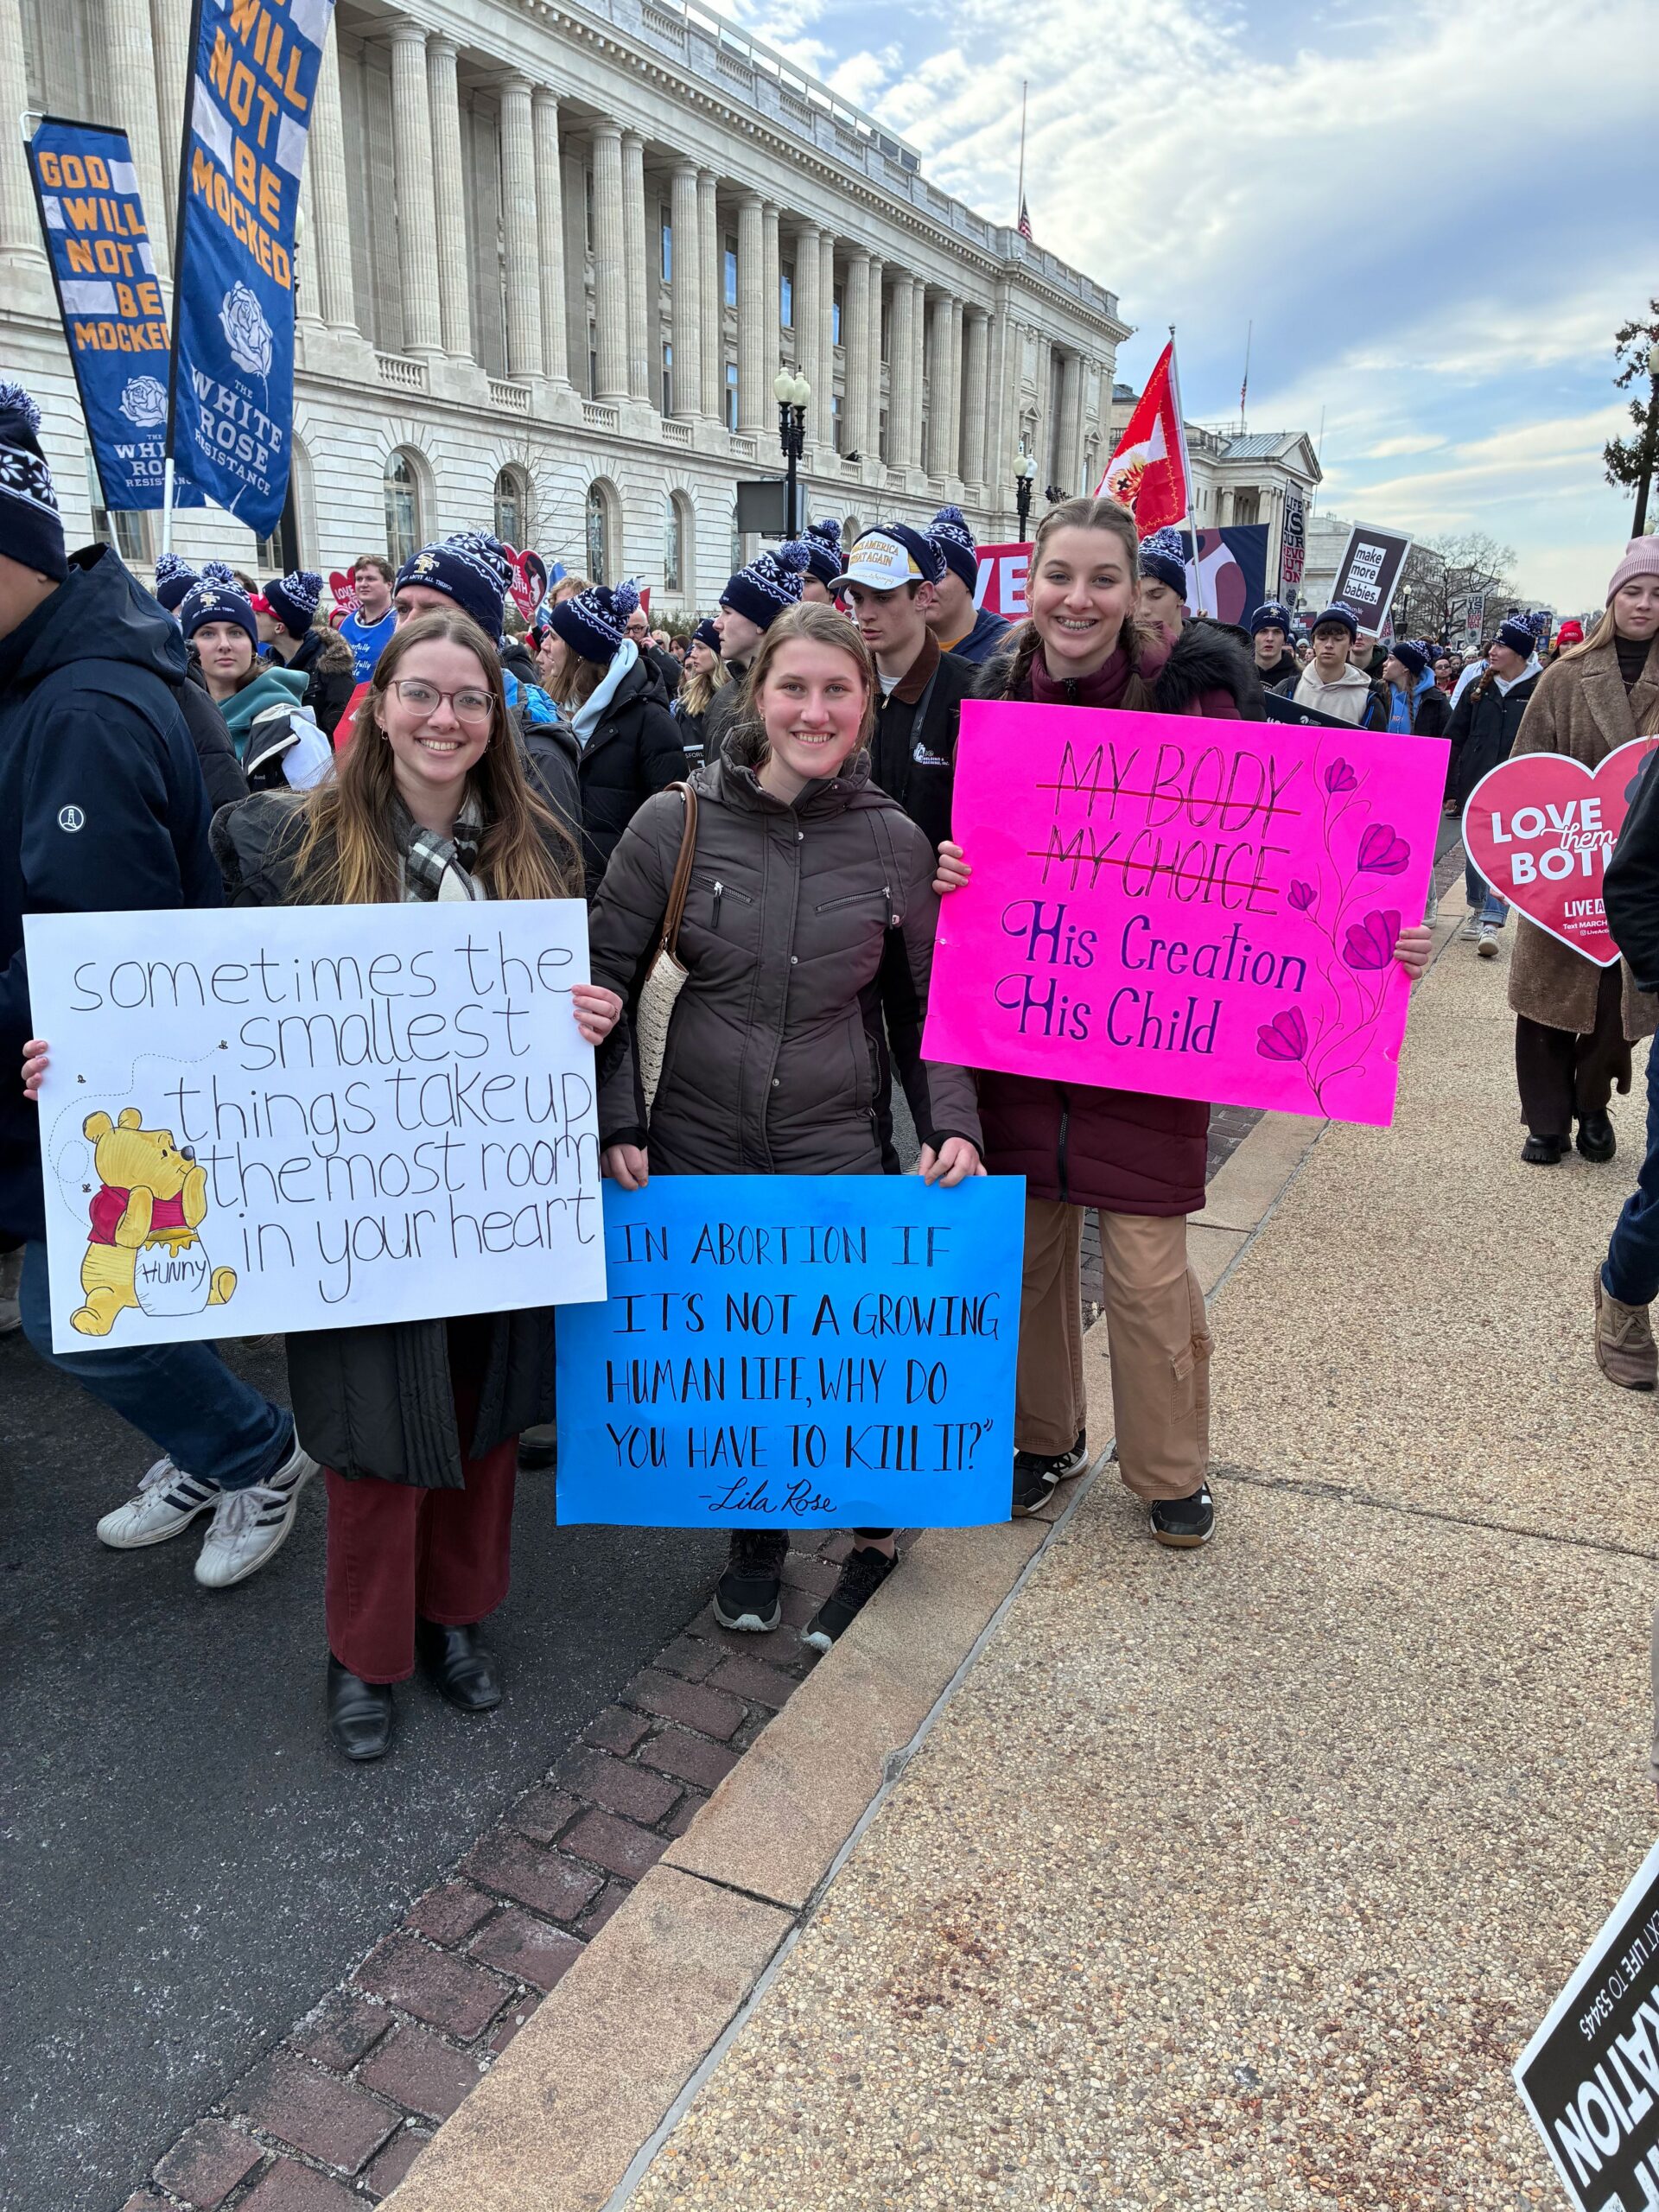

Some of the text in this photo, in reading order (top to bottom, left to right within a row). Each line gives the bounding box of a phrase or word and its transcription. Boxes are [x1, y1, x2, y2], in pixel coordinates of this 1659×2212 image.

[230, 0, 307, 111] WILL
[209, 26, 278, 149] NOT
[39, 152, 110, 189] GOD
[234, 136, 282, 232] BE
[62, 197, 147, 236] WILL
[192, 148, 291, 290] MOCKED
[66, 239, 134, 276] NOT
[116, 282, 162, 317] BE
[190, 364, 283, 454] WHITE
[234, 379, 253, 399] THE
[113, 442, 165, 458] WHI
[200, 404, 269, 474] ROSE
[130, 460, 166, 476] RO
[195, 429, 271, 496] RESISTANCE
[1285, 509, 1304, 537] IS
[1287, 495, 1303, 512] LIFE
[864, 540, 899, 556] AMERICA
[866, 552, 893, 567] AGAIN
[1356, 549, 1382, 564] make
[334, 585, 355, 600] LOVE
[512, 582, 528, 594] OTH
[972, 556, 1028, 613] VE
[1344, 583, 1377, 603] babies.
[1351, 565, 1376, 580] more
[1054, 741, 1304, 838] MY BODY
[1491, 798, 1603, 843] LOVE
[1541, 822, 1618, 850] them
[1042, 825, 1292, 915] MY CHOICE
[1565, 899, 1594, 917] LIVE
[1001, 899, 1306, 993] His Creation
[70, 931, 574, 1012] sometimes the
[240, 998, 530, 1071] smallest
[994, 974, 1222, 1054] His Child
[164, 1077, 375, 1158] things
[481, 1131, 602, 1192] room
[238, 1187, 596, 1303] in your heart
[613, 1222, 951, 1268] IN ABORTION IF
[613, 1292, 1000, 1341] IT'S NOT A GROWING
[607, 1357, 725, 1404] HUMAN
[819, 1357, 887, 1403] WHY
[906, 1358, 947, 1404] DO
[606, 1423, 667, 1468] YOU
[689, 1426, 768, 1468] HAVE
[789, 1423, 826, 1468] TO
[846, 1424, 931, 1471] KILL
[780, 1478, 837, 1516] Rose
[1621, 1937, 1649, 1982] LIFE
[1608, 1969, 1629, 1999] TO
[1579, 1989, 1614, 2042] 53445
[1554, 1984, 1659, 2188] ATION
